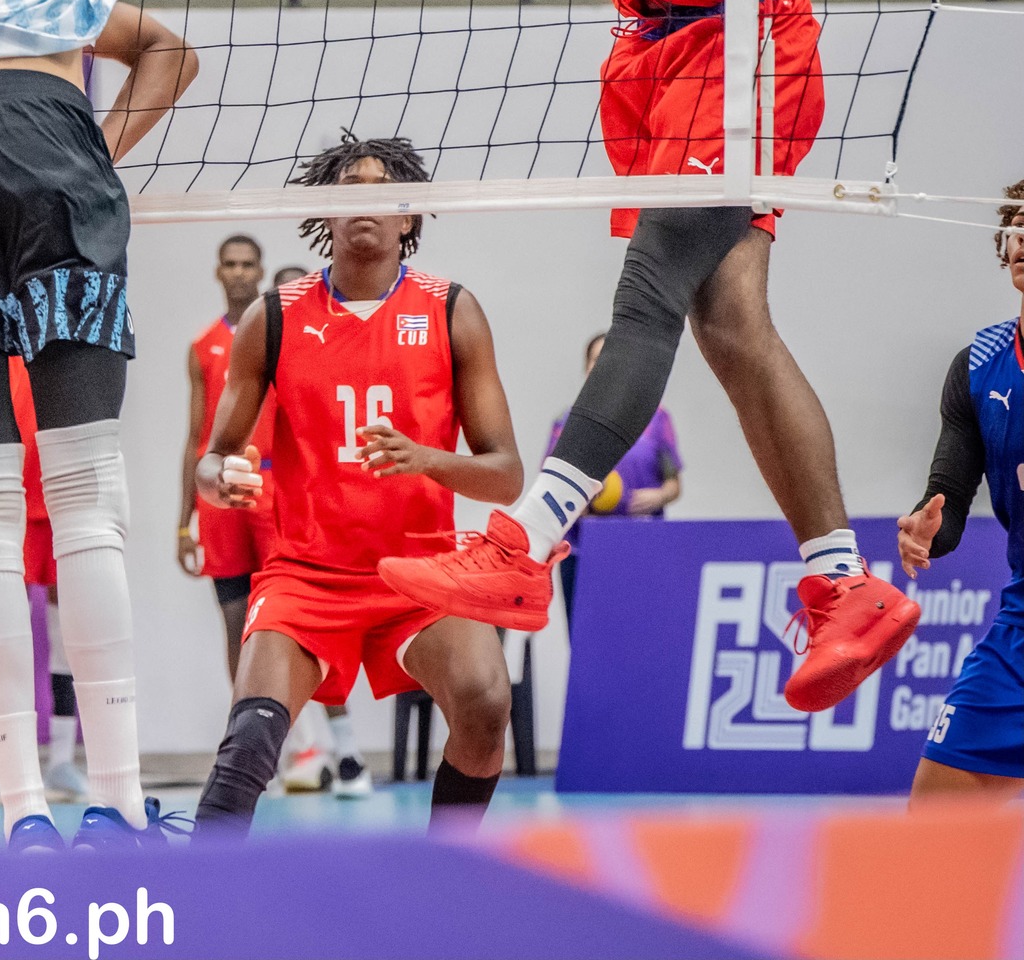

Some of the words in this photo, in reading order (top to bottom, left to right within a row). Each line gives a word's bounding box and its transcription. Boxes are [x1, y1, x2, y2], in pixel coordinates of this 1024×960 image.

[397, 330, 428, 346] CUB
[336, 384, 394, 463] 16
[895, 633, 951, 679] Pan
